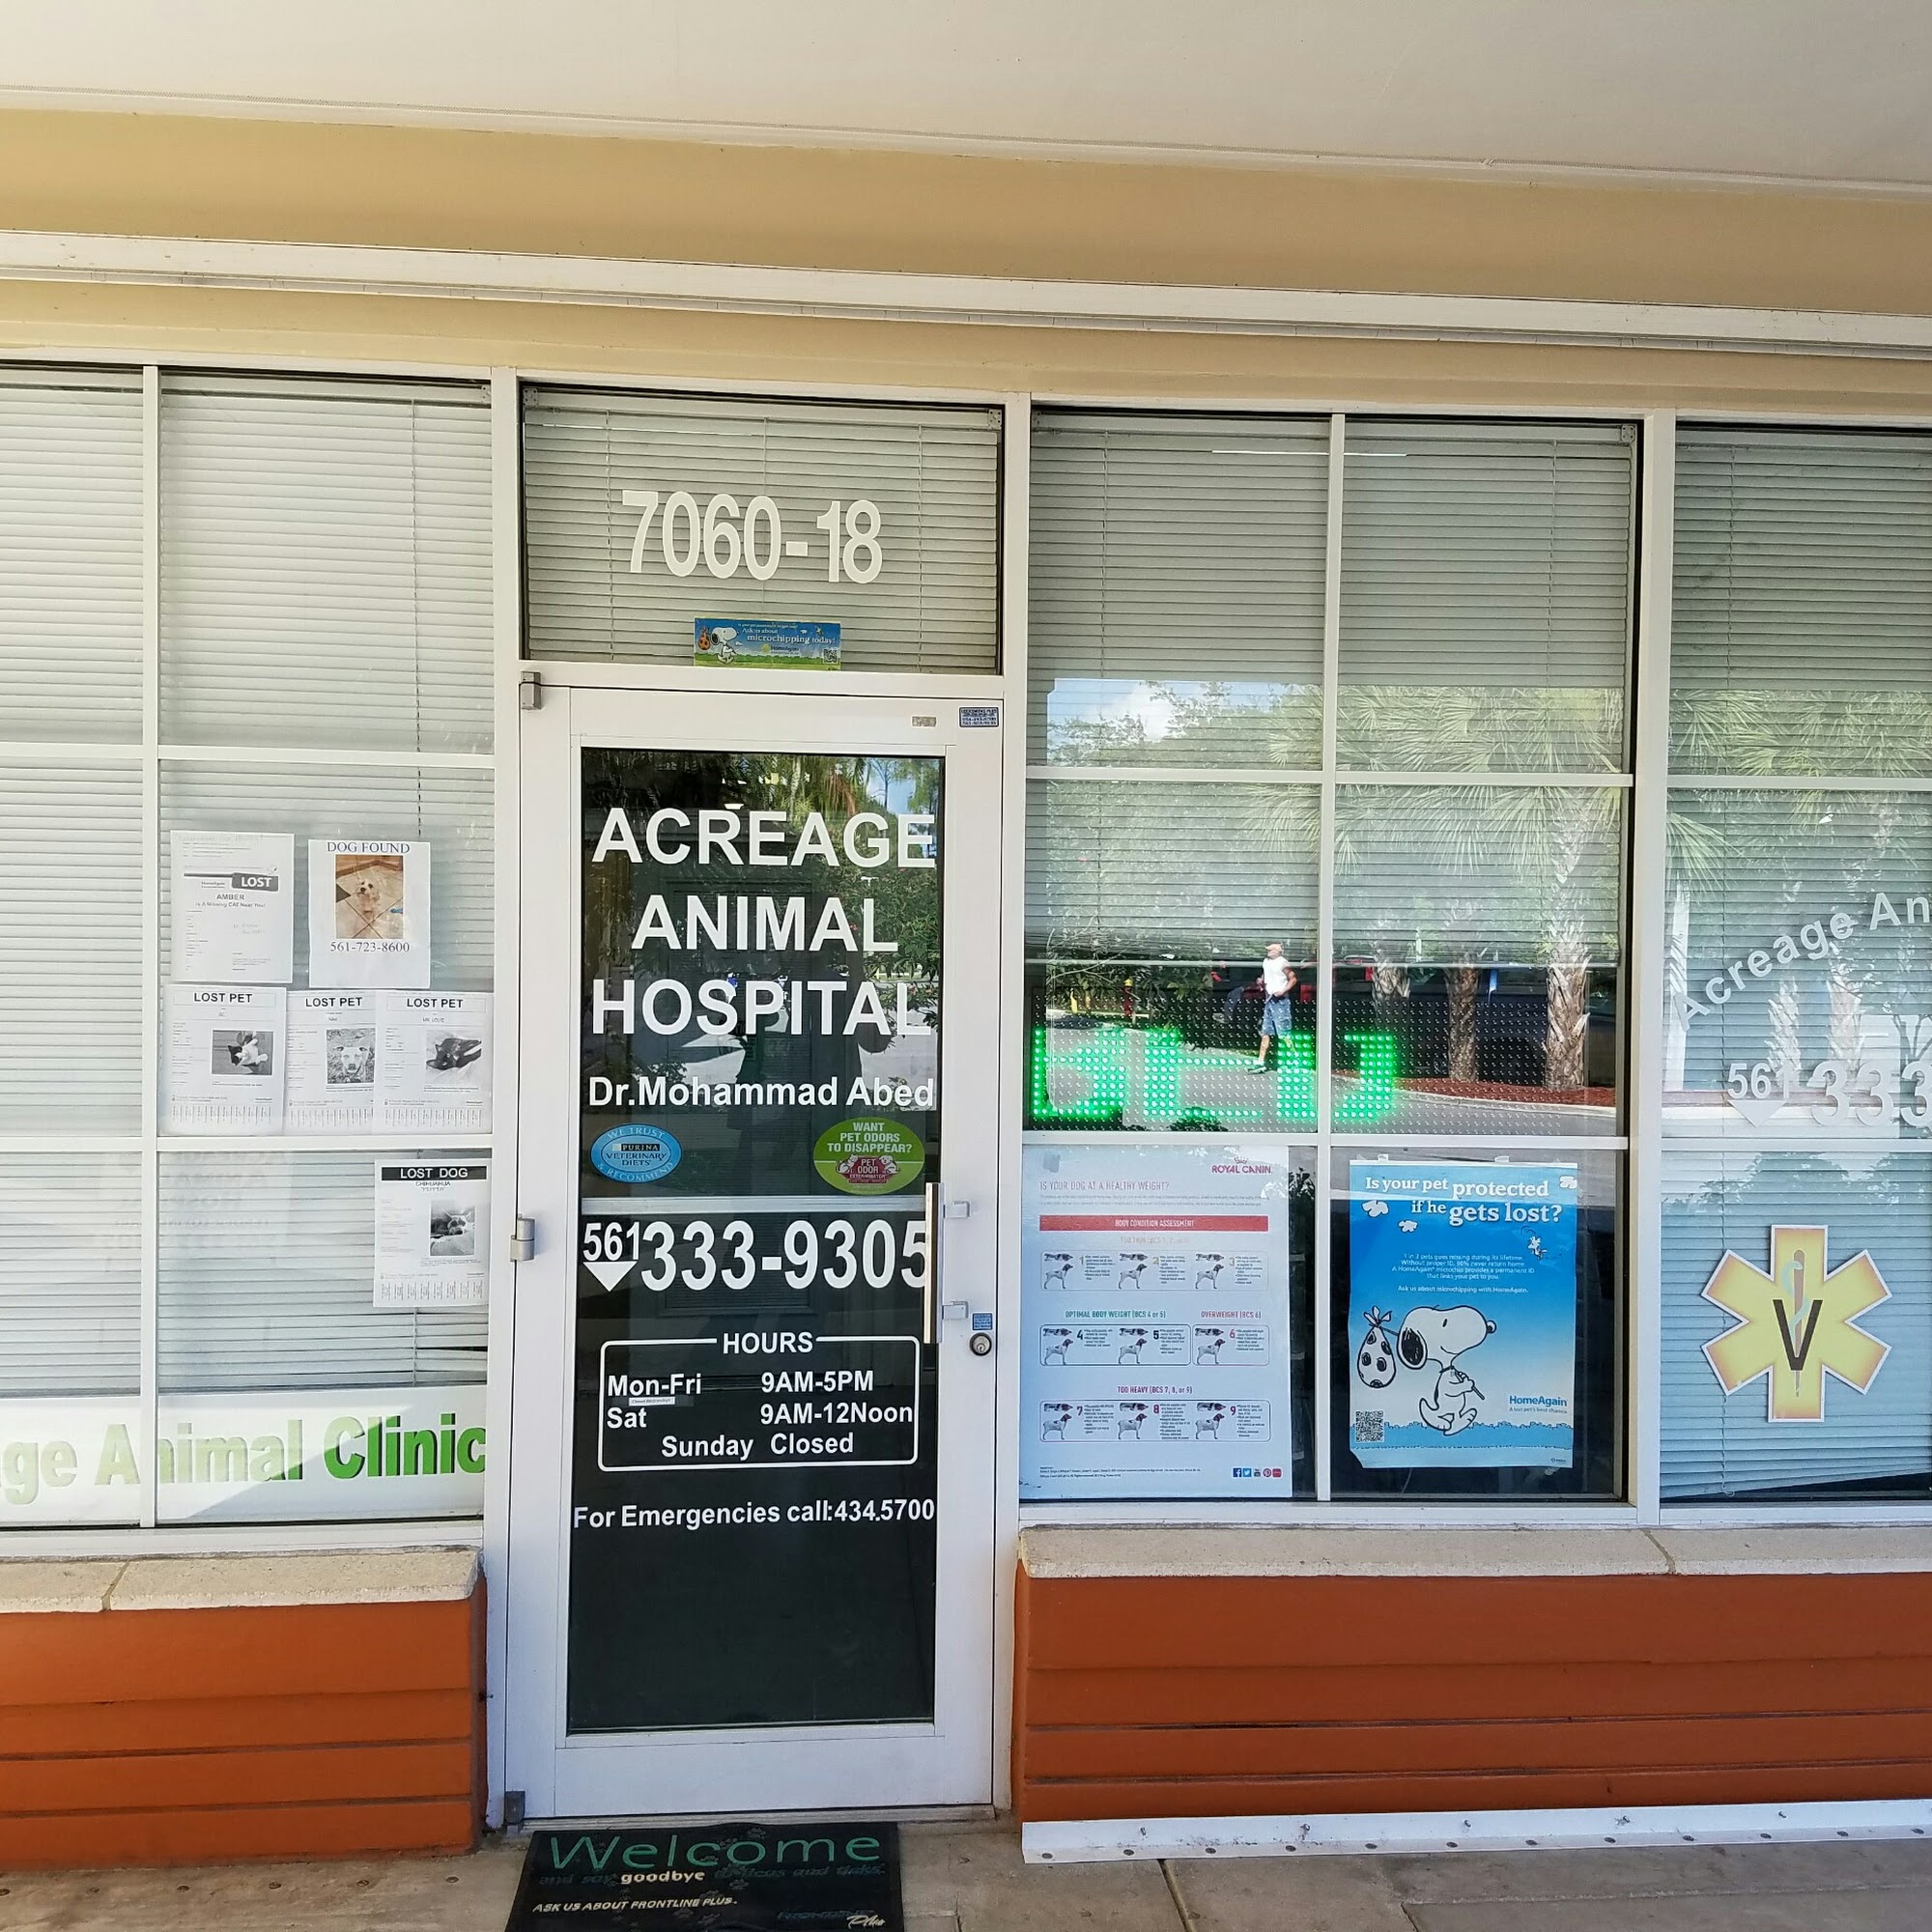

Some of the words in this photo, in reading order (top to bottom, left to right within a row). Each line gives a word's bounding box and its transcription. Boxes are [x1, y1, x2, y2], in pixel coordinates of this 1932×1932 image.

[621, 490, 883, 584] 7060-18
[747, 635, 810, 644] microchipping
[591, 807, 936, 868] ACREAGE
[327, 842, 357, 852] DOG
[362, 842, 411, 853] FOUND
[242, 877, 272, 888] LOST
[631, 895, 898, 952] ANIMAL
[330, 942, 410, 952] 561-723-8600
[1673, 912, 1857, 1032] Acreage
[194, 992, 226, 1003] LOST
[229, 994, 253, 1003] PET
[305, 997, 336, 1008] LOST
[339, 997, 363, 1007] PET
[407, 998, 437, 1008] LOST
[440, 999, 464, 1009] PET
[592, 979, 931, 1036] HOSPITAL
[1727, 1063, 1790, 1099] 561
[589, 1076, 838, 1107] Dr.Mohammad
[846, 1076, 934, 1107] Abed
[852, 1122, 885, 1131] WANT
[607, 1128, 624, 1139] WE
[630, 1127, 666, 1139] TRUST
[839, 1133, 861, 1142] PET
[864, 1133, 900, 1143] ODORS
[827, 1143, 841, 1151] TO
[844, 1143, 913, 1152] DISAPPEAR?
[605, 1152, 668, 1161] VETERINARY
[400, 1168, 433, 1179] LOST
[439, 1168, 469, 1179] DOG
[607, 1162, 673, 1181] RECOMMEND
[1211, 1165, 1240, 1174] ROYAL
[1040, 1181, 1047, 1190] IS
[1049, 1181, 1069, 1190] YOUR
[1070, 1181, 1086, 1190] DOG
[1088, 1181, 1096, 1190] AT
[1099, 1181, 1104, 1190] A
[1106, 1181, 1135, 1190] HEALTHY
[1138, 1181, 1169, 1191] WEIGHT?
[1365, 1177, 1379, 1189] Is
[1381, 1179, 1418, 1192] your
[1422, 1178, 1448, 1193] pet
[1452, 1180, 1549, 1199] protected
[1411, 1200, 1425, 1213] if
[1427, 1201, 1447, 1213] he
[1449, 1203, 1499, 1226] gets
[1504, 1202, 1562, 1222] lost?
[1115, 1219, 1128, 1228] BODY
[1130, 1219, 1158, 1228] CONDITION
[582, 1221, 639, 1261] 561
[641, 1219, 926, 1292] 333-9305
[1079, 1256, 1084, 1265] 1
[1152, 1257, 1159, 1265] 2
[1229, 1257, 1235, 1266] 3
[1076, 1329, 1083, 1340] 4
[1153, 1330, 1159, 1340] 5
[1229, 1329, 1236, 1339] 6
[1773, 1299, 1823, 1371] V
[723, 1332, 813, 1354] HOURS
[608, 1374, 702, 1397] Mon-Fri
[761, 1370, 874, 1393] 9AM-5PM
[1509, 1395, 1568, 1407] HomeAgain
[1076, 1406, 1083, 1416] 7
[1153, 1405, 1160, 1414] 8
[1230, 1406, 1236, 1416] 9
[606, 1406, 647, 1429] Sat
[760, 1402, 914, 1426] 9AM-12Noon
[662, 1435, 754, 1462] Sunday
[770, 1433, 854, 1456] Closed
[0, 1439, 77, 1505] ge
[324, 1412, 487, 1480] Clinic
[573, 1506, 615, 1529] For
[621, 1501, 781, 1531] Emergencies
[550, 1834, 881, 1869] Welcome
[620, 1871, 705, 1885] goodbye
[582, 1901, 628, 1911] ABOUT
[630, 1899, 700, 1910] FRONTLINE
[702, 1897, 738, 1906] PLUS.
